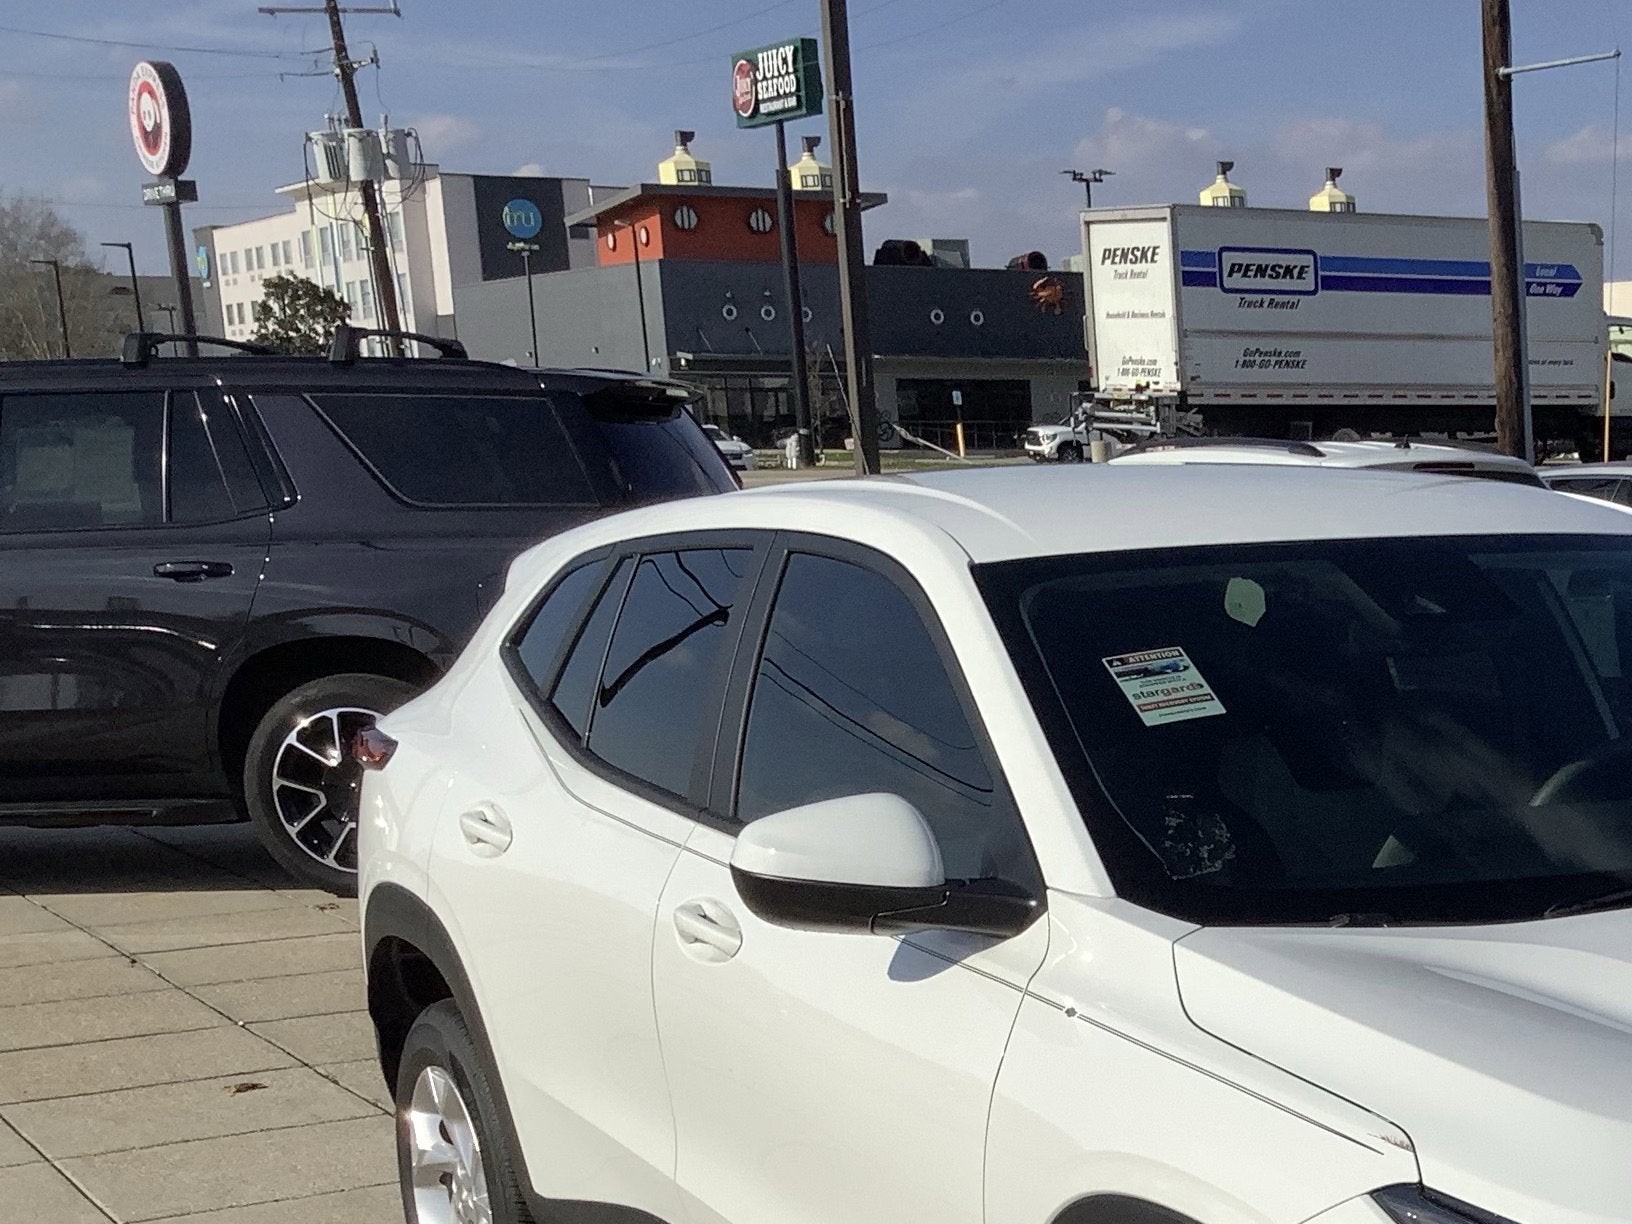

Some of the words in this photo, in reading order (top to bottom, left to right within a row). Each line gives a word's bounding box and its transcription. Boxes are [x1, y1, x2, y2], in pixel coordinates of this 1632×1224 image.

[755, 45, 795, 81] JUICY
[757, 73, 797, 100] SEAFOOD
[1101, 245, 1160, 266] PENSKE
[1113, 269, 1130, 281] Truck
[1129, 268, 1149, 279] Rental
[1226, 262, 1310, 280] PENSKE
[1529, 283, 1545, 294] One
[1546, 284, 1563, 297] Way
[1237, 297, 1265, 309] Truck
[1266, 298, 1301, 310] Rental
[1242, 347, 1302, 359] GoPenske.com
[1233, 359, 1308, 370] 1-800-GO-PENSKE
[1129, 650, 1181, 664] ATTENTION
